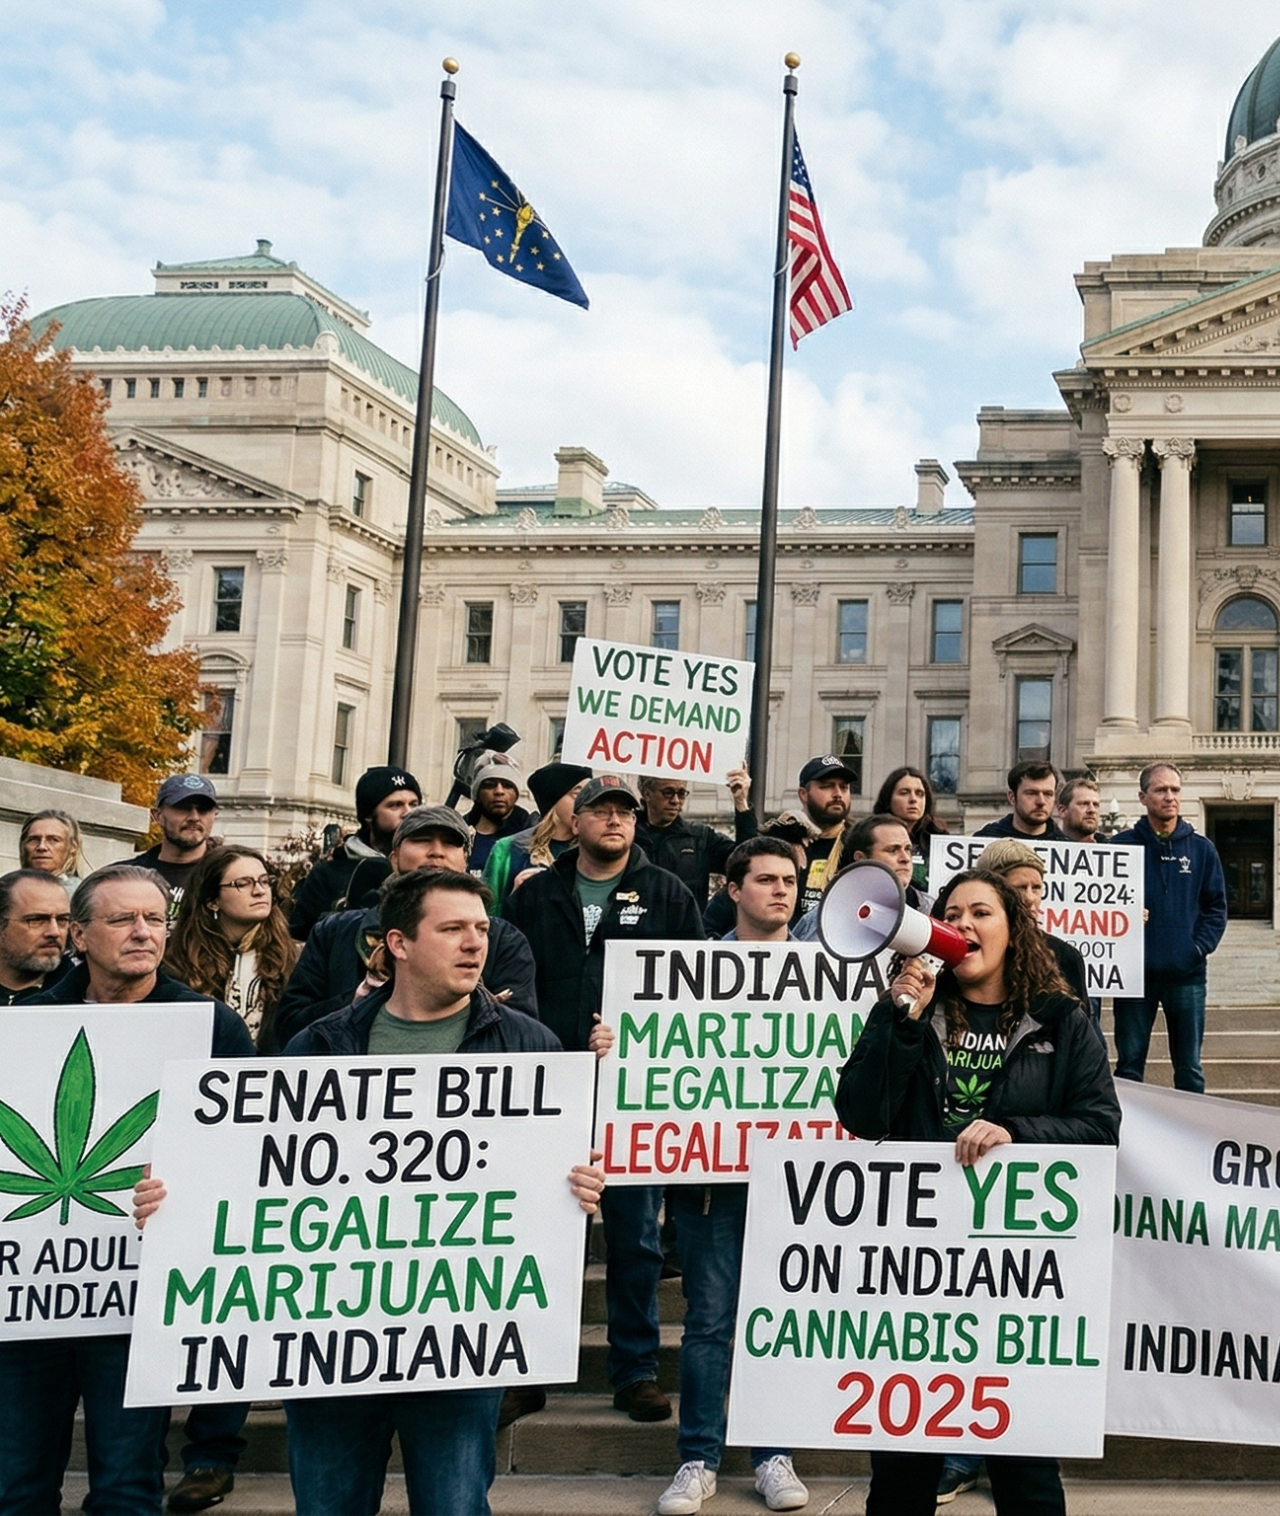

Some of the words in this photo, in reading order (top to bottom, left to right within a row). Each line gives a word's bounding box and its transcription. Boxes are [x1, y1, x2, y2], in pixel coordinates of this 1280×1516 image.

[592, 645, 673, 687] VOTE
[683, 659, 739, 697] YES
[577, 686, 622, 718] WE
[629, 694, 742, 734] DEMAND
[586, 727, 713, 774] ACTION
[1073, 881, 1136, 906] 2024:
[1045, 907, 1130, 938] MAND
[633, 949, 886, 1002] INDIANA
[194, 1067, 417, 1126] SENATE
[436, 1064, 563, 1119] BILL
[615, 1065, 841, 1112] LEGALIZA
[258, 1133, 350, 1187] NO.
[365, 1130, 489, 1184] 320:
[212, 1190, 517, 1256] LEGALIZE
[783, 1160, 942, 1228] VOTE
[962, 1160, 1079, 1233] YES
[1120, 1193, 1210, 1247] IANA
[32, 1235, 143, 1275] ADUL
[779, 1243, 843, 1294] ON
[856, 1246, 1065, 1299] INDIANA
[163, 1253, 549, 1326] MARIJUANA
[176, 1334, 246, 1393] IN
[269, 1321, 530, 1388] INDIANA
[745, 1305, 979, 1363] CANNABIS
[996, 1314, 1100, 1367] BILL
[833, 1371, 1011, 1440] 2025
